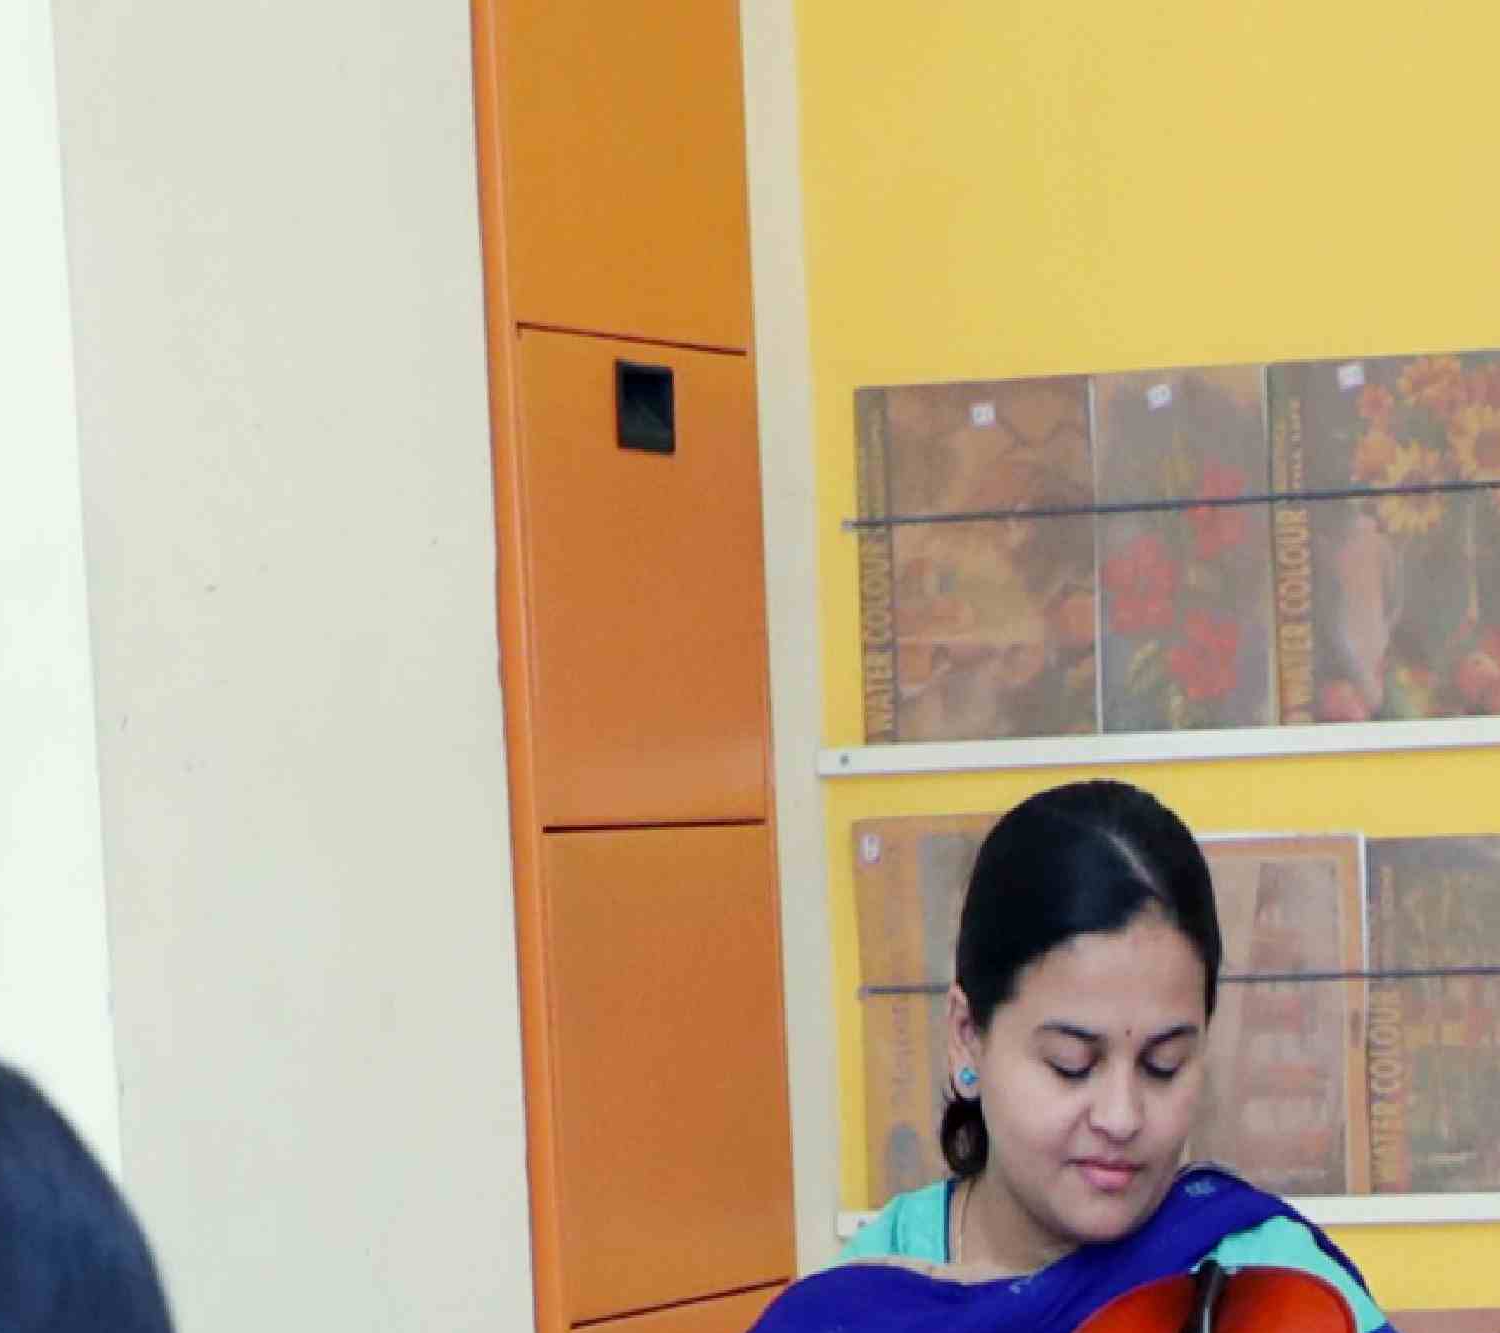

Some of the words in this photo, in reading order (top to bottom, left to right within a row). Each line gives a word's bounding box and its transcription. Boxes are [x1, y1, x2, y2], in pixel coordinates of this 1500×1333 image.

[859, 540, 892, 644] COLOUR
[1277, 509, 1311, 615] COLOUR
[864, 651, 894, 734] WATER
[1279, 623, 1313, 706] WATER
[1368, 989, 1403, 1095] COLOUR
[1369, 1101, 1402, 1183] WATER
